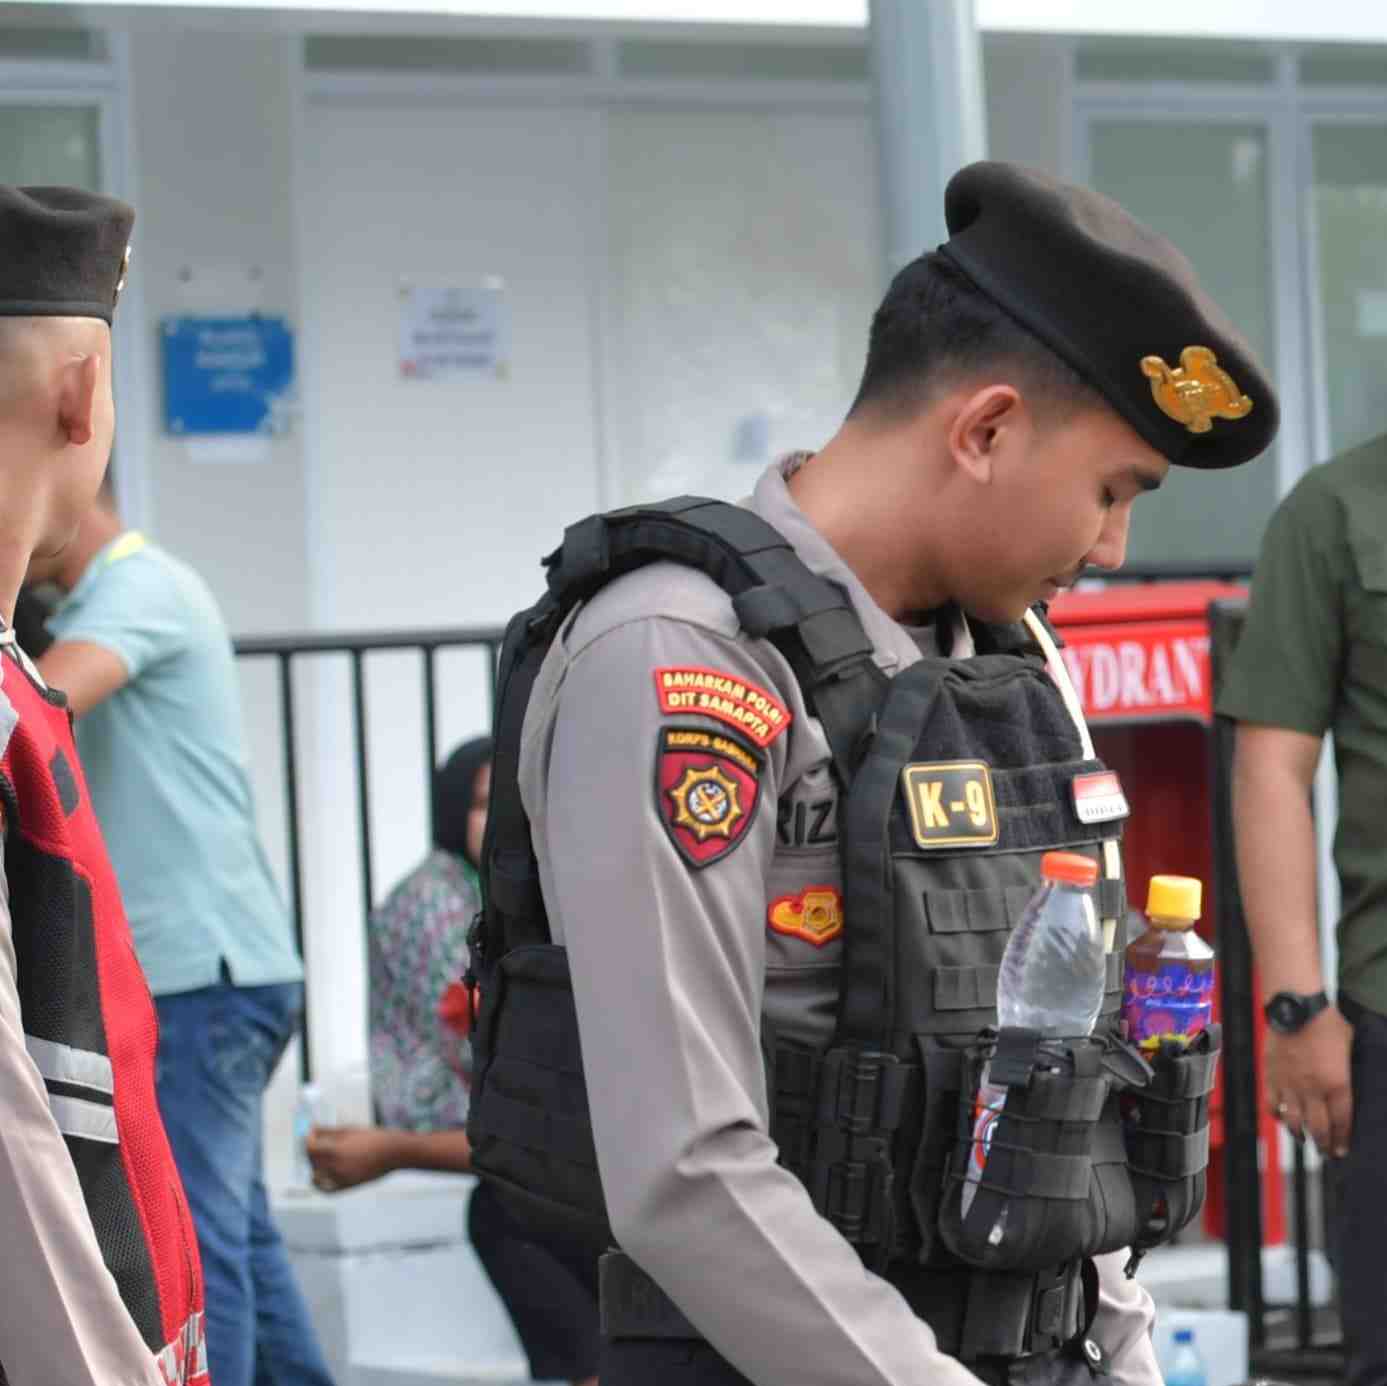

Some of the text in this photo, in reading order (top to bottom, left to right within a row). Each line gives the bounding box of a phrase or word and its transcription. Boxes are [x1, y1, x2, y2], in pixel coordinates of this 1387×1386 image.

[1060, 637, 1211, 709] YDRAN
[663, 672, 784, 725] BAHARKAM POLRI
[667, 692, 769, 738] DIT SAMAPTA
[917, 780, 988, 828] K-9
